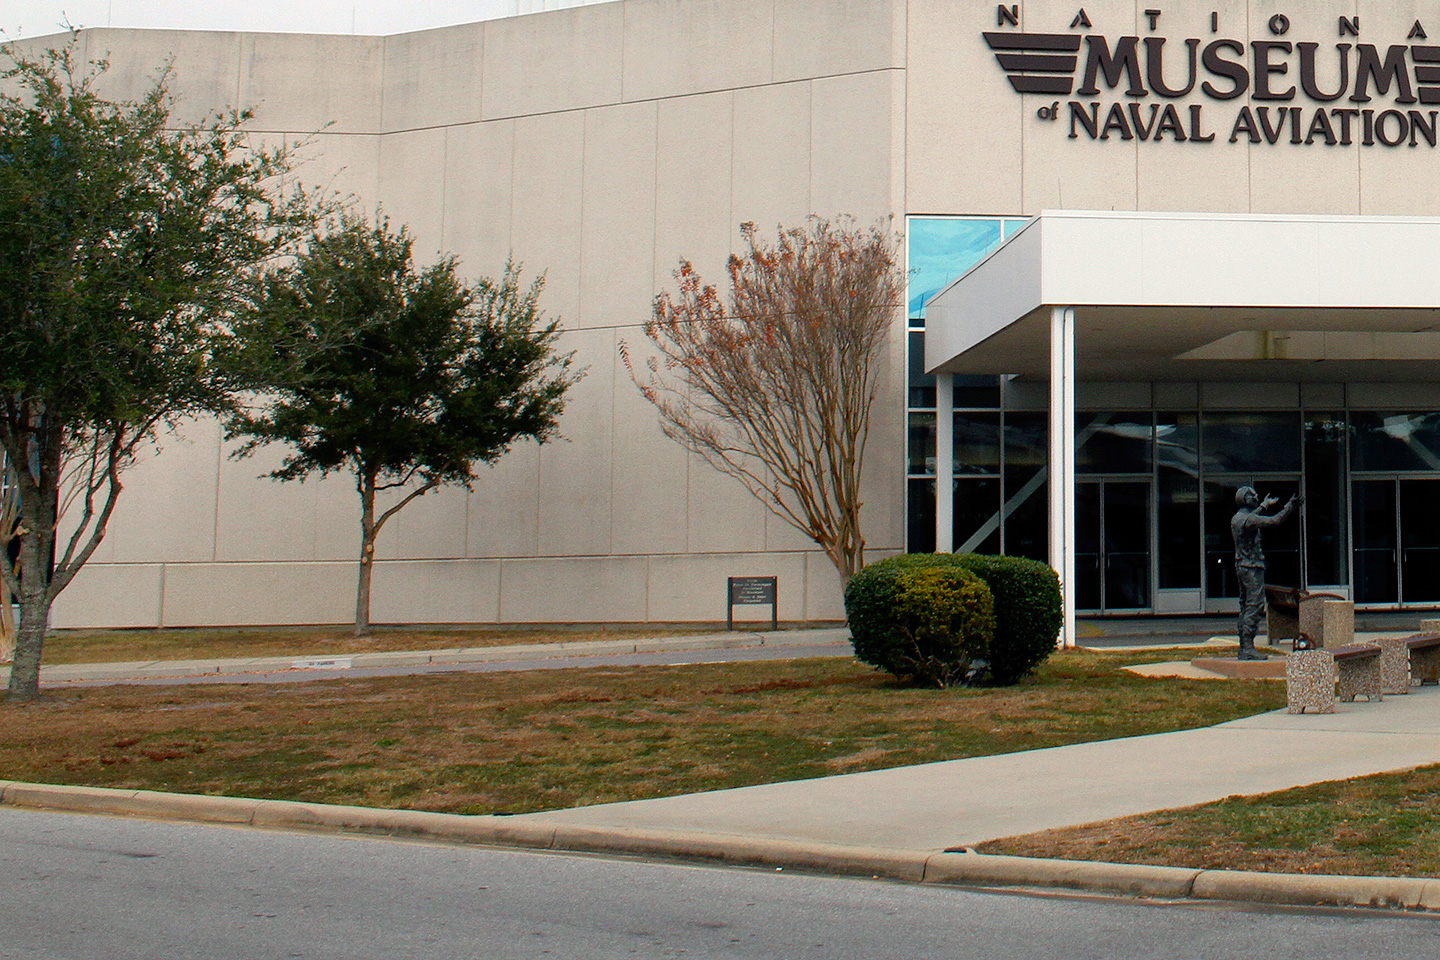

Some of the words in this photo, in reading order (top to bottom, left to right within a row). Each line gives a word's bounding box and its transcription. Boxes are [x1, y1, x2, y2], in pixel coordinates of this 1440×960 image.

[1076, 33, 1419, 105] MUSEUM
[1037, 102, 1060, 122] of
[1067, 101, 1216, 144] NAVAL
[1228, 106, 1439, 148] AVIATION
